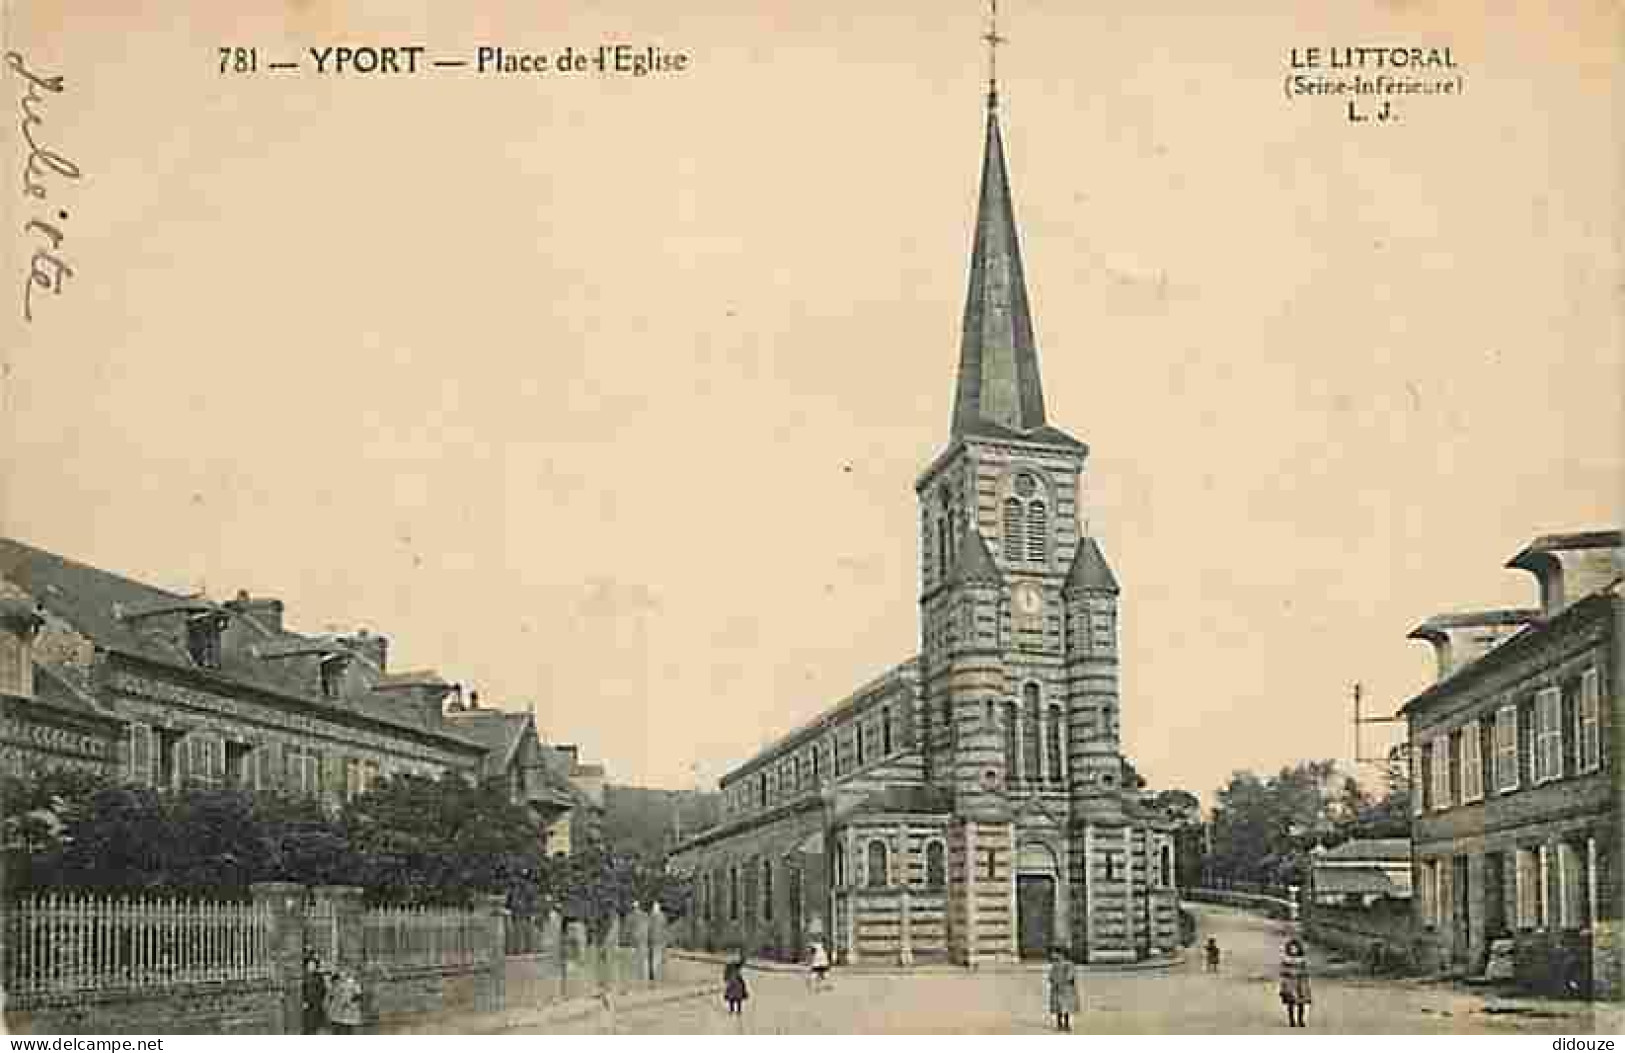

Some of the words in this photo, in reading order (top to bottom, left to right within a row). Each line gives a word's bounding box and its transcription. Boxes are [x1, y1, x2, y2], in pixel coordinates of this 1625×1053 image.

[218, 46, 257, 73] 781
[309, 46, 424, 73] YPORT
[477, 46, 548, 73] Place
[556, 46, 588, 72] de
[1291, 47, 1320, 68] LE
[1330, 46, 1458, 68] LITTORAL
[1349, 100, 1369, 121] L.
